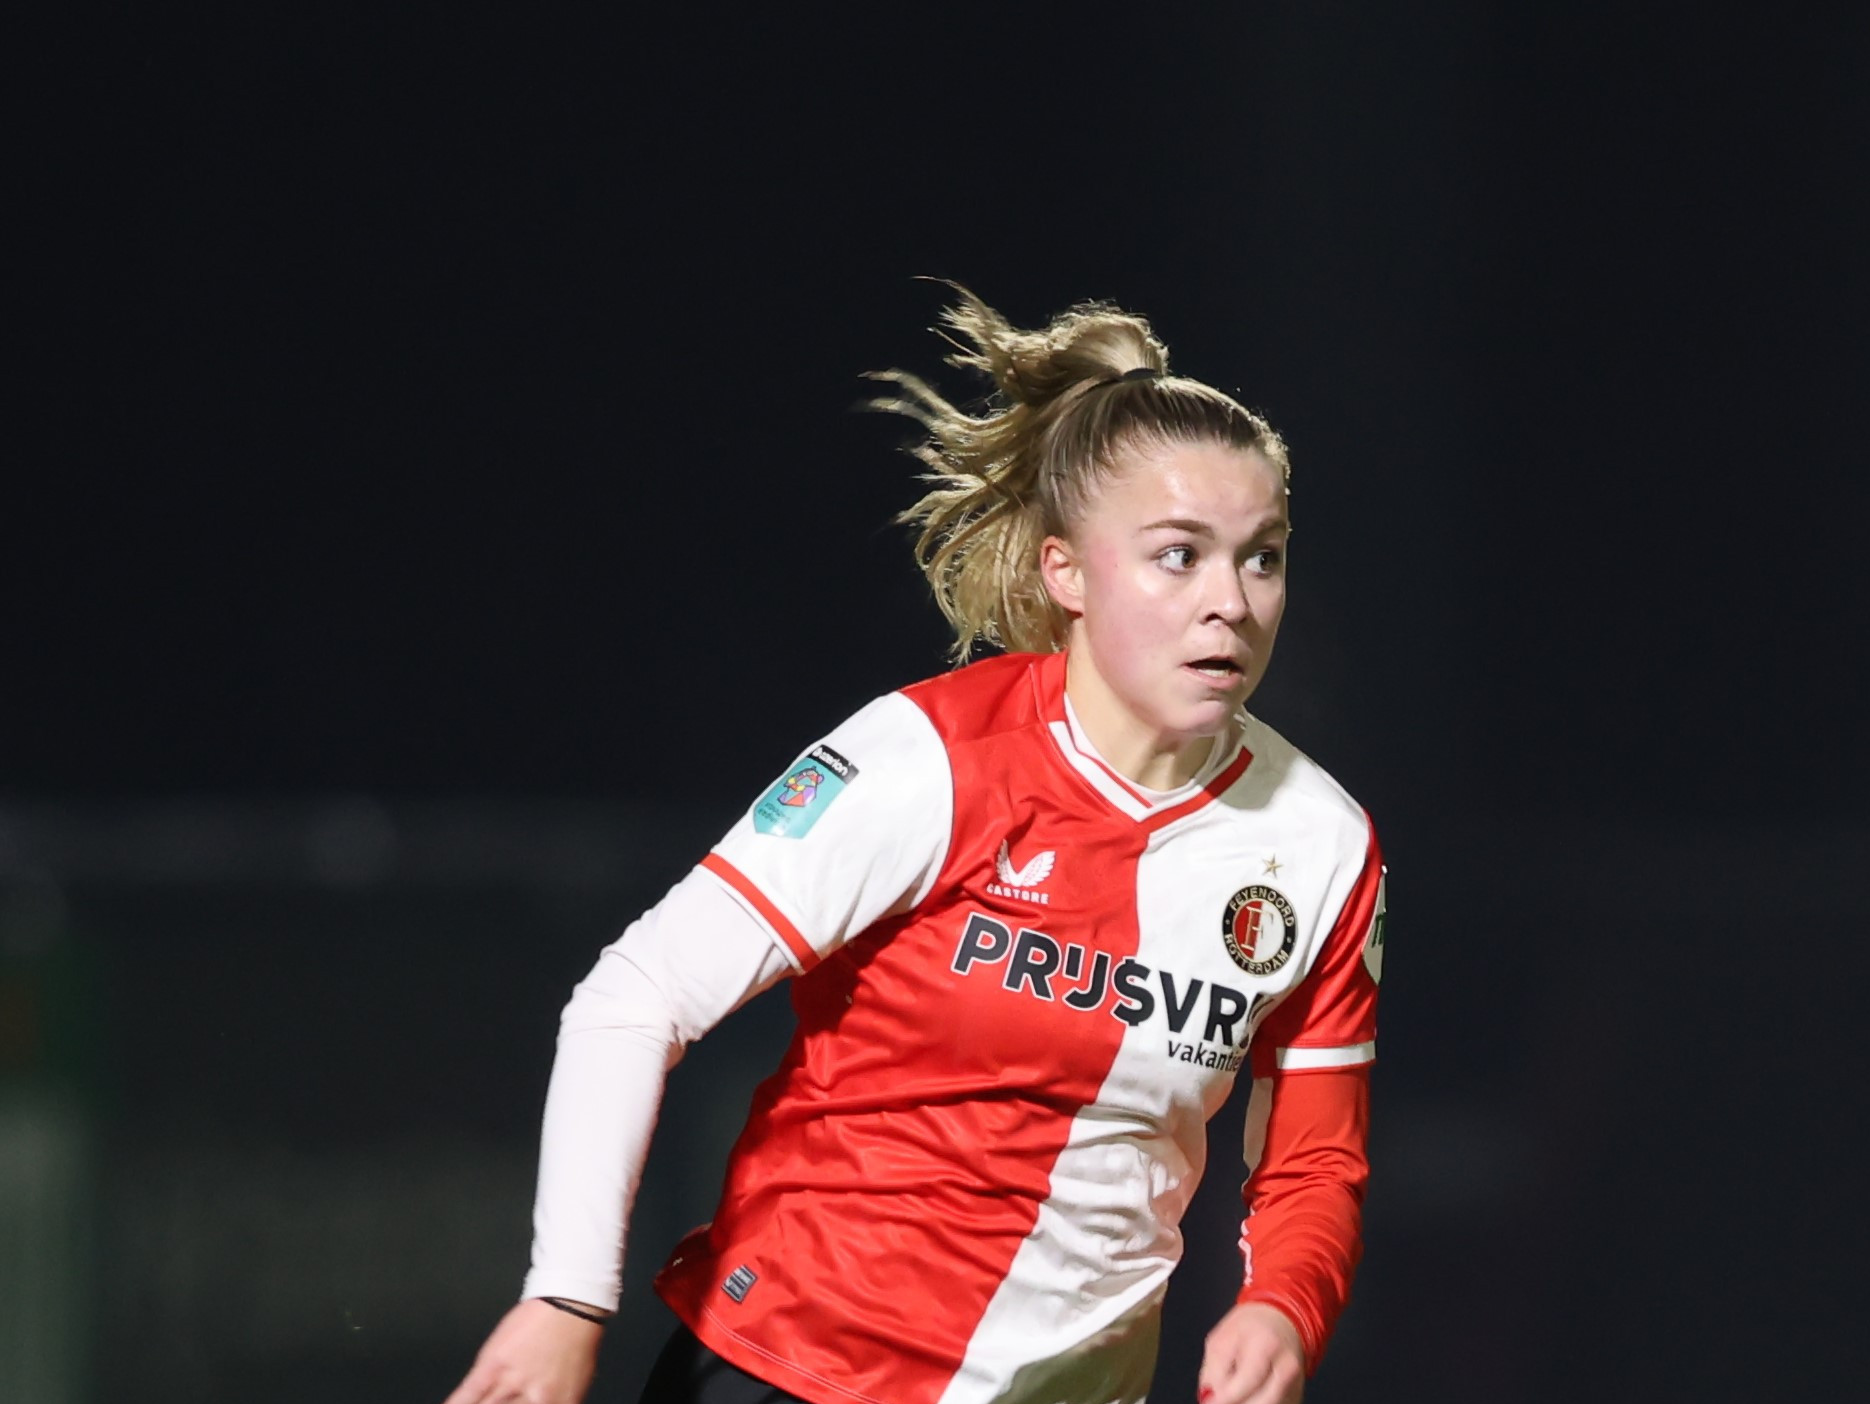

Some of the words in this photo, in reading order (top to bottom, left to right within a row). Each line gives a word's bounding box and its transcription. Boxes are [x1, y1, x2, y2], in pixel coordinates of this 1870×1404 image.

[986, 883, 1049, 905] CASTORE
[1229, 886, 1296, 928] FEYENOORD
[1224, 933, 1290, 974] ROTTERDAM
